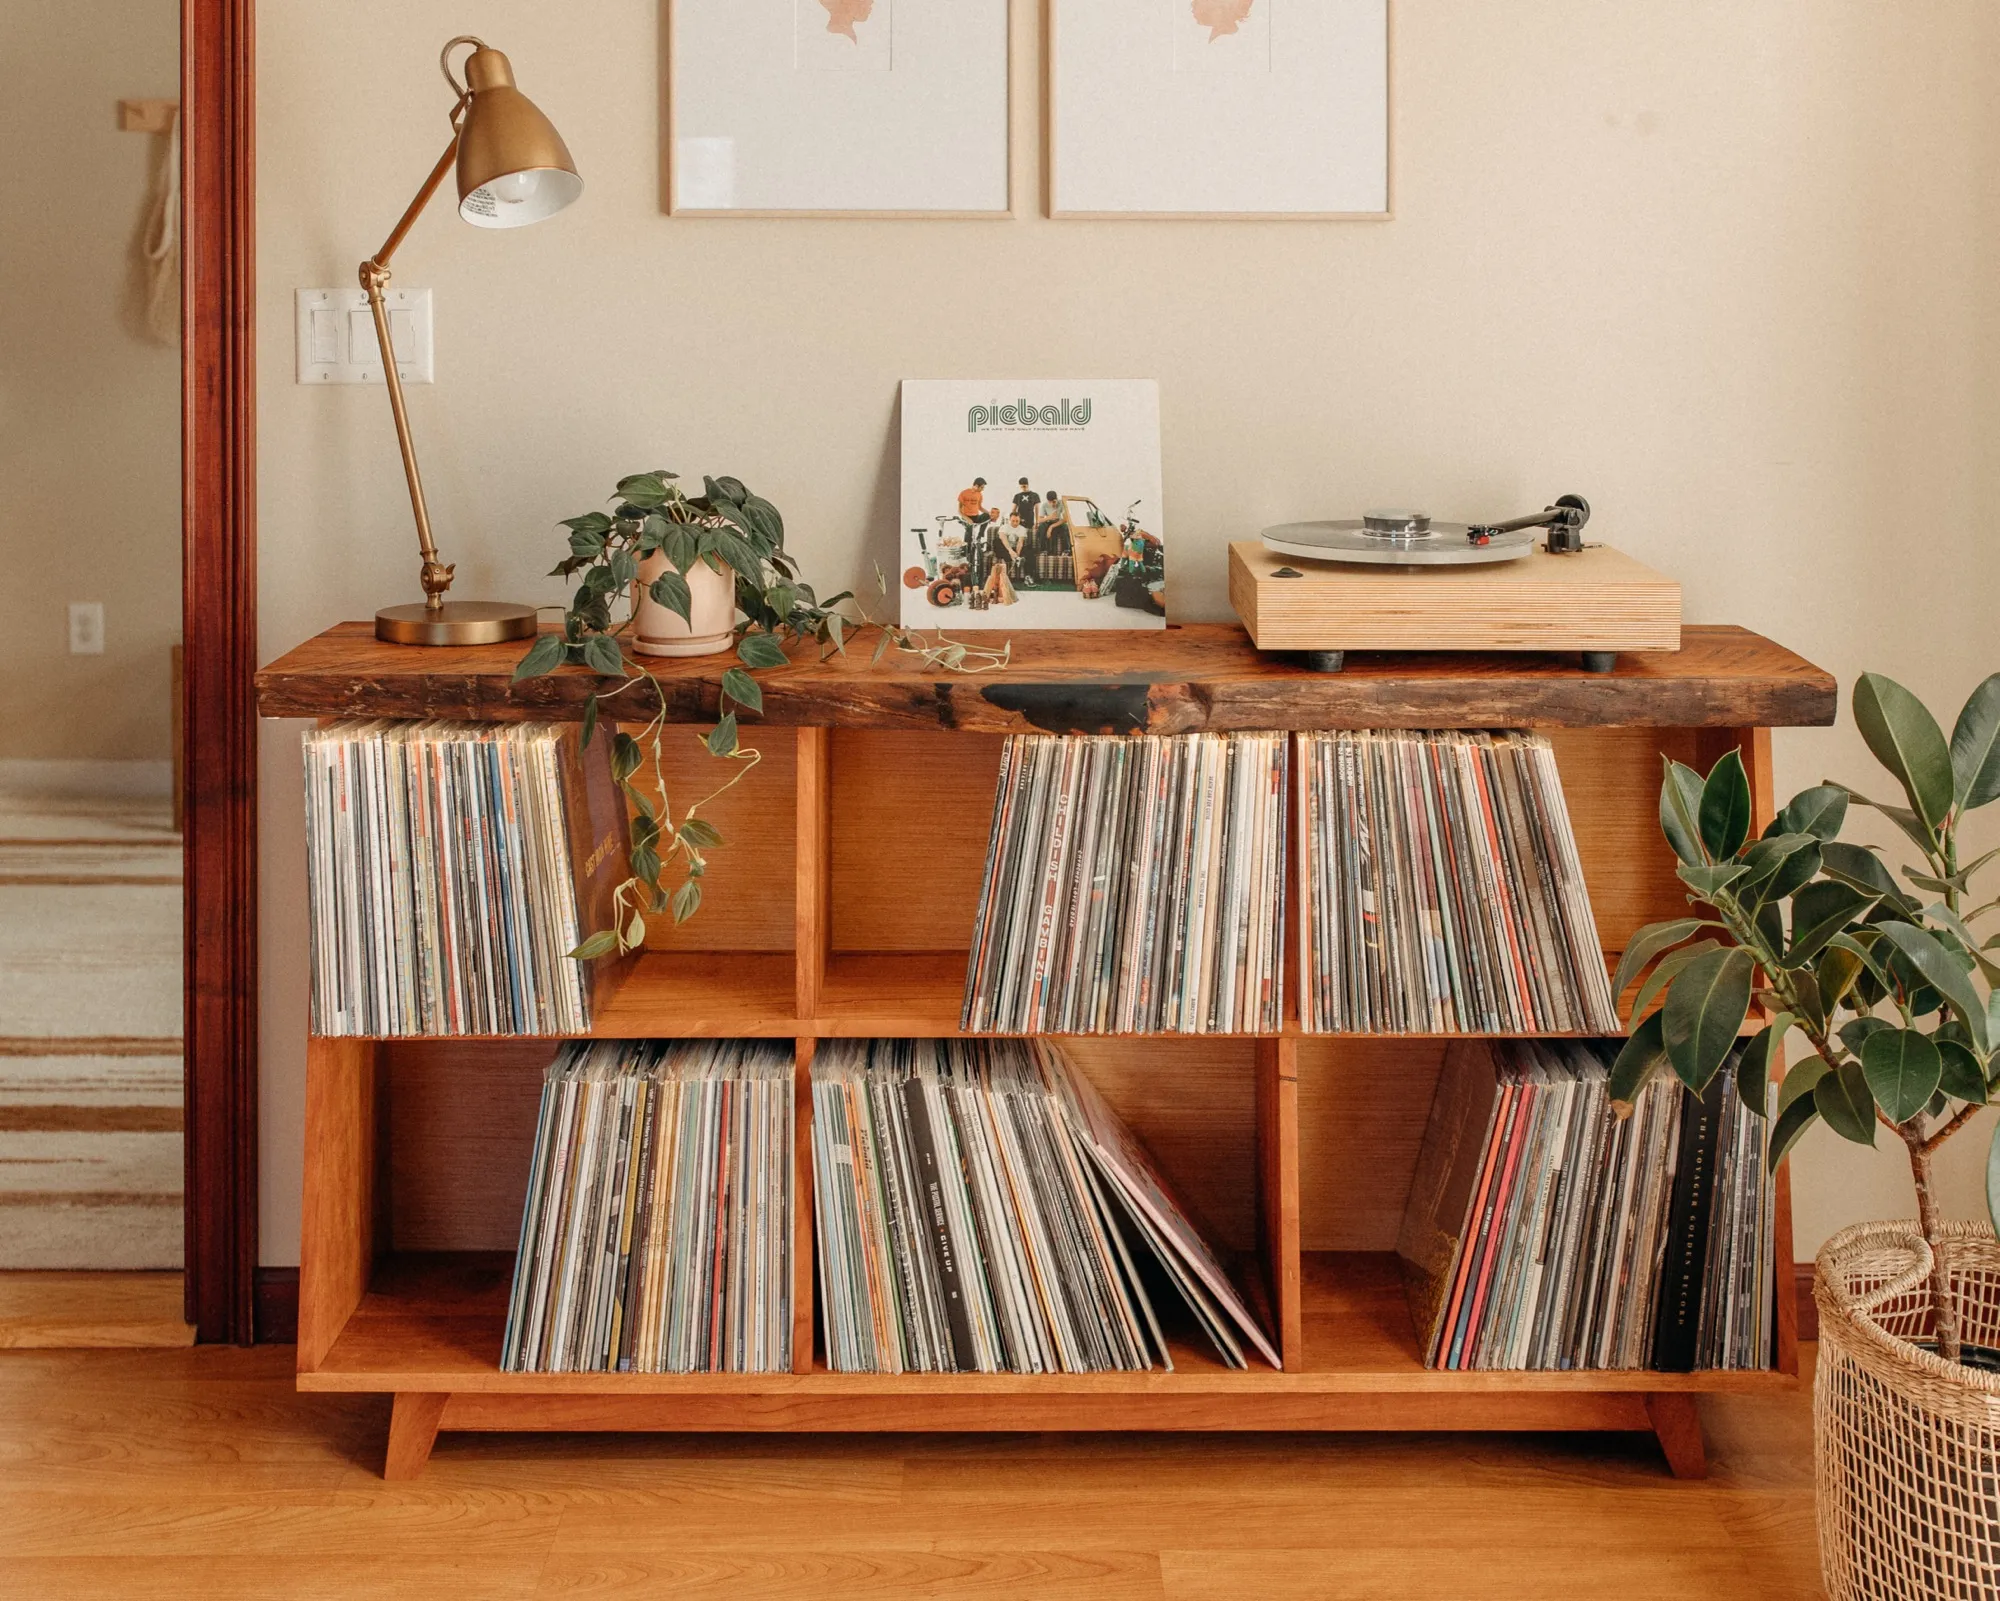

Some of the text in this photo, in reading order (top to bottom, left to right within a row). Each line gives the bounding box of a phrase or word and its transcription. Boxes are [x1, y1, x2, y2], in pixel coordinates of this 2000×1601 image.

[968, 398, 1091, 433] piebald
[1033, 793, 1068, 982] CHILDISH GAMBINO
[1599, 1131, 1607, 1147] Called
[1546, 1154, 1554, 1172] TAKING
[1539, 1191, 1547, 1213] SUNDAY
[1589, 1190, 1597, 1206] Theory
[928, 1181, 952, 1272] THE POSTAL SERVICE GIVE UP
[1677, 1115, 1707, 1325] THE VOYAGER GOLDEN RECORD
